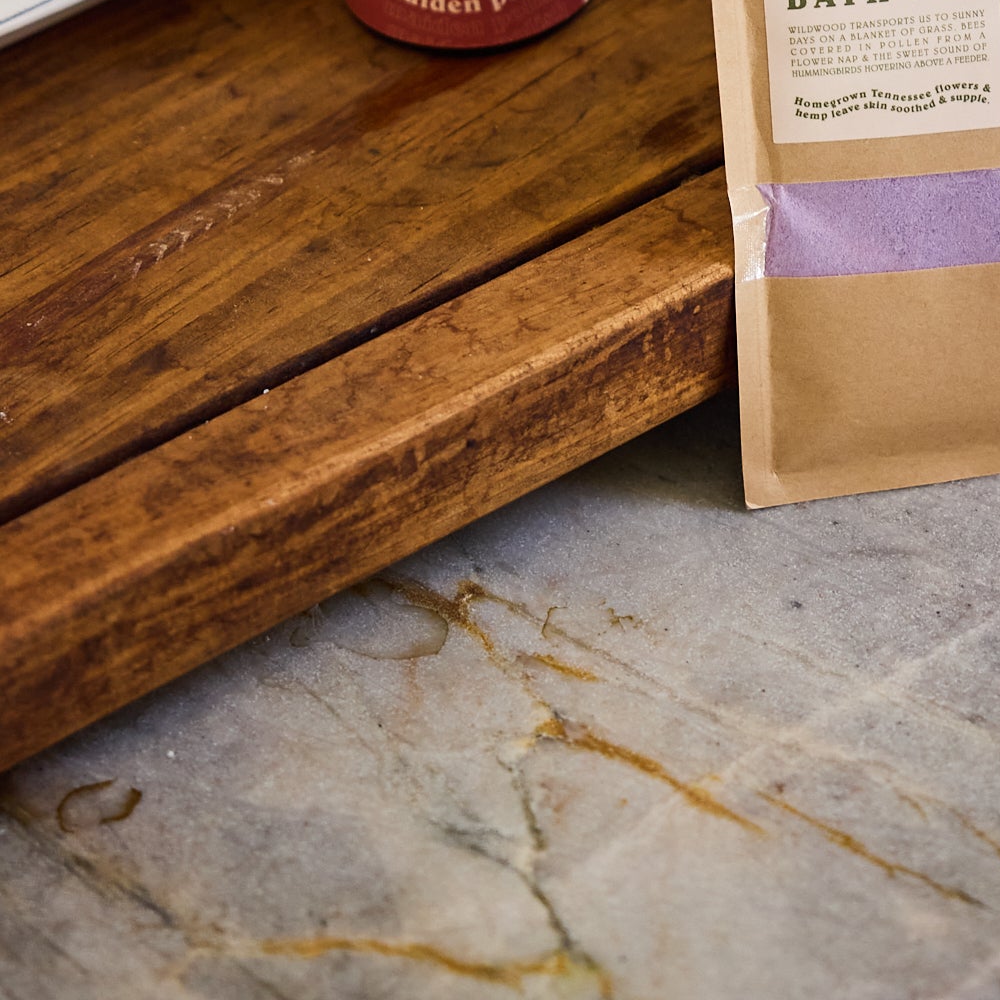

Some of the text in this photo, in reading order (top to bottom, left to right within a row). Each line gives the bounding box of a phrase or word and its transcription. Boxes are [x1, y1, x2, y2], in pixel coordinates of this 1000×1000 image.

[788, 9, 985, 34] WILDWOOD TRANSPORTS US TO SUNNY
[789, 36, 815, 45] DAYS
[840, 33, 846, 41] A
[850, 30, 896, 41] BLANKET
[901, 28, 915, 36] OF
[962, 20, 985, 30] BEES
[791, 45, 851, 55] COVERED
[880, 37, 929, 48] POLLEN
[937, 33, 971, 43] FROM
[791, 57, 833, 66] FLOWER
[838, 55, 858, 64] NAP
[862, 54, 869, 62] &
[873, 52, 892, 60] THE
[896, 49, 929, 58] SWEET
[933, 45, 969, 55] SOUND
[792, 66, 861, 77] HUMMINGBIRDS
[865, 62, 911, 72] HOVERING
[914, 58, 944, 68] ABOVE
[794, 82, 991, 109] Homegrown Tennessee flowers &
[795, 93, 990, 121] hemp leave skin soothed & supple.
